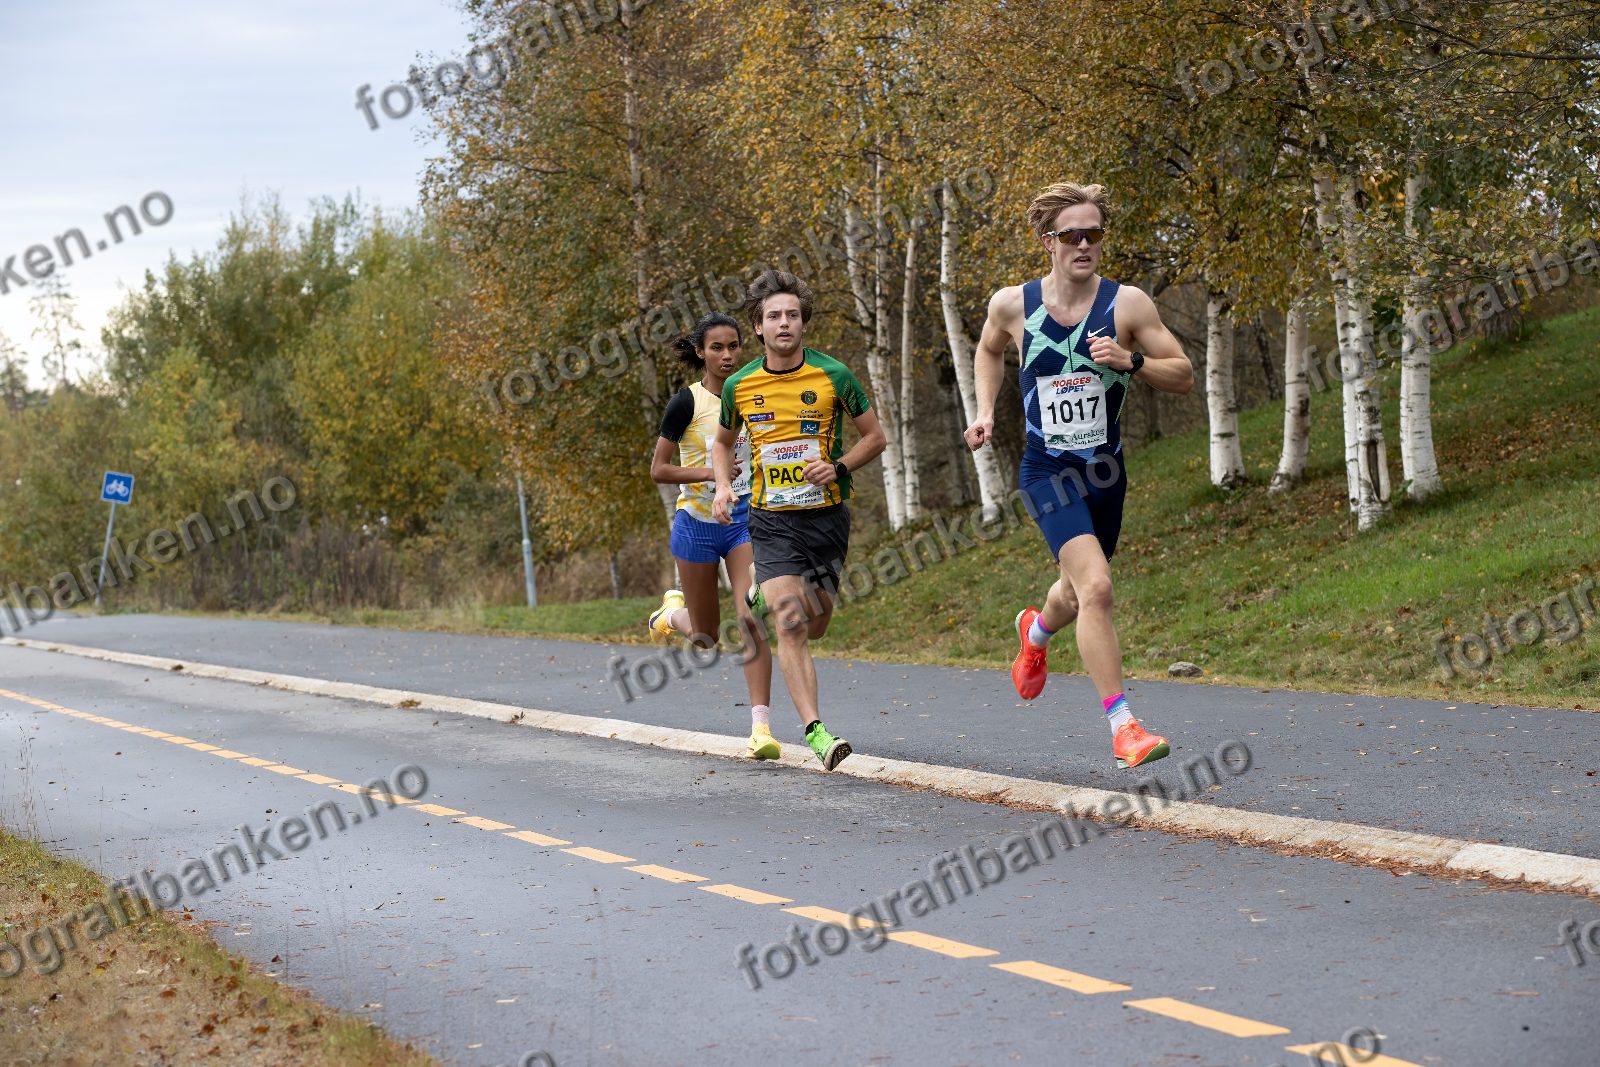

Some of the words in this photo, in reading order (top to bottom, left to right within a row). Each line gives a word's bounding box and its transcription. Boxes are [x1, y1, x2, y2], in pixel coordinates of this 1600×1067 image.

[1052, 376, 1092, 388] NORGES
[1056, 384, 1086, 394] LØPET
[1047, 396, 1100, 424] 1017
[771, 444, 809, 454] NORGES
[777, 451, 804, 460] LØPET
